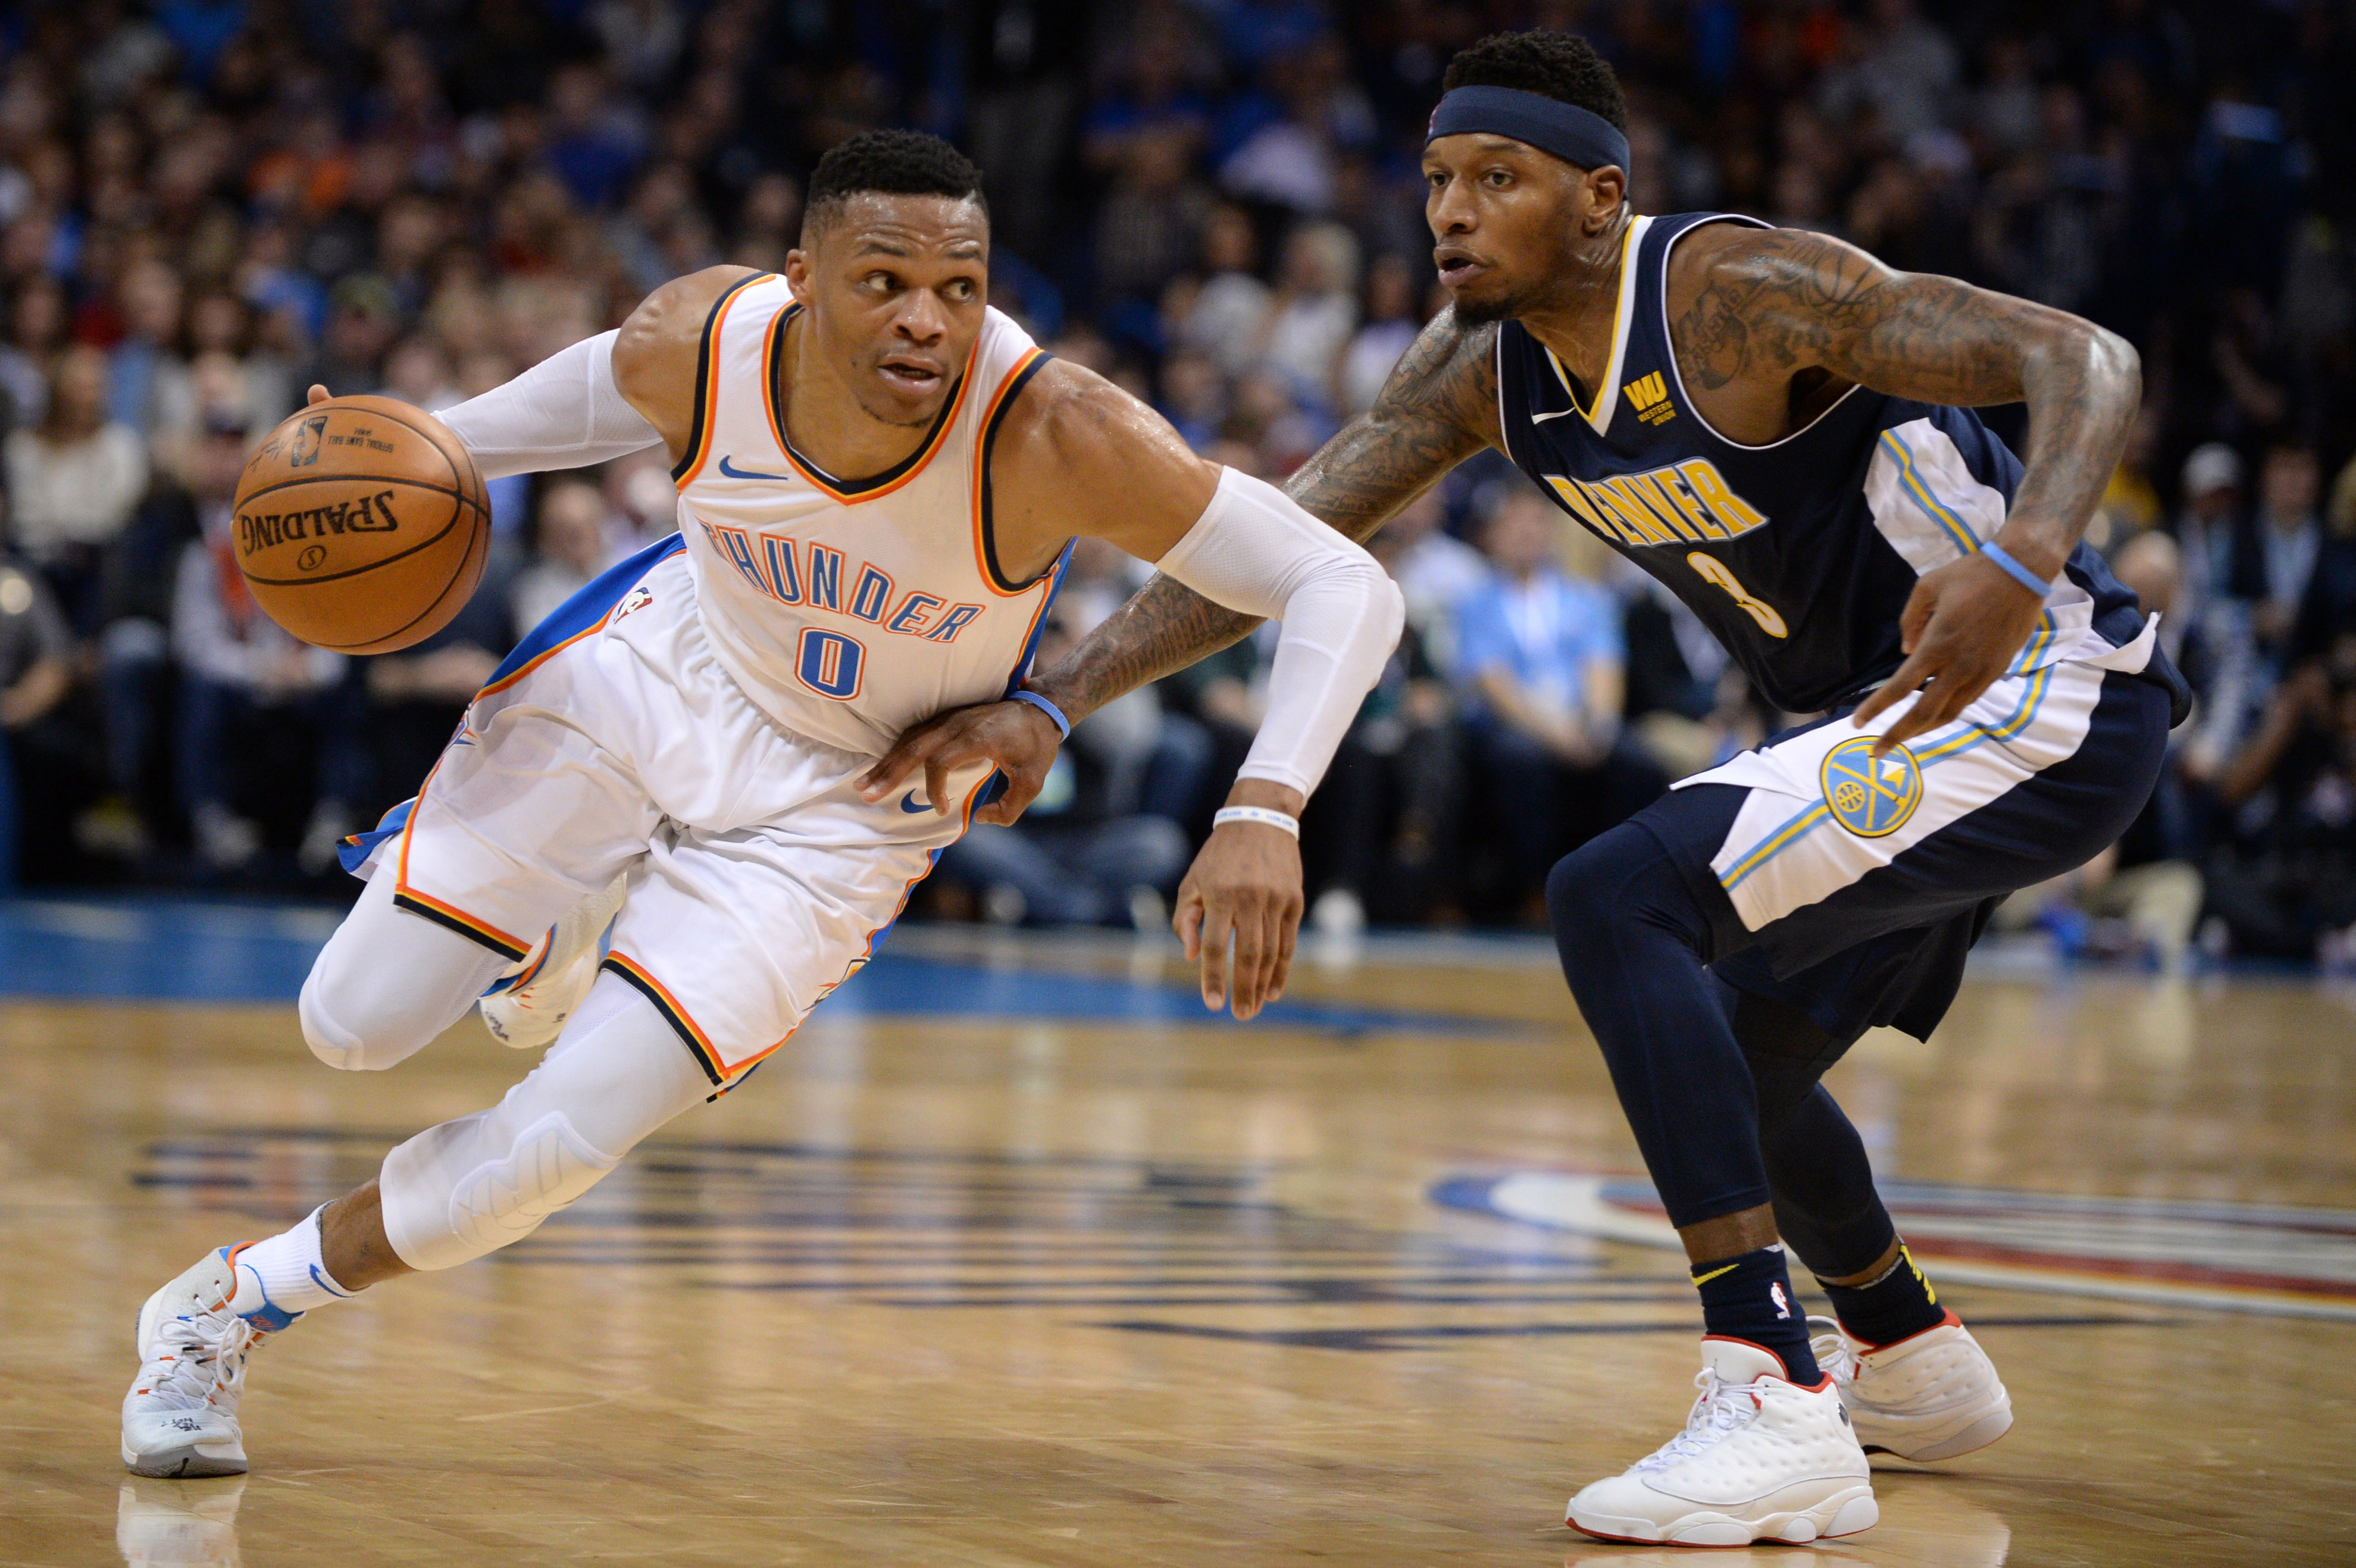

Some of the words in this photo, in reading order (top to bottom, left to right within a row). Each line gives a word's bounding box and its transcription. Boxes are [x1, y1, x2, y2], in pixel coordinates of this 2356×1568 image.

[1623, 370, 1668, 411] WU
[240, 489, 398, 556] SPALDING
[1540, 456, 1770, 547] DENVER
[1687, 552, 1788, 639] 3
[794, 626, 866, 701] 0
